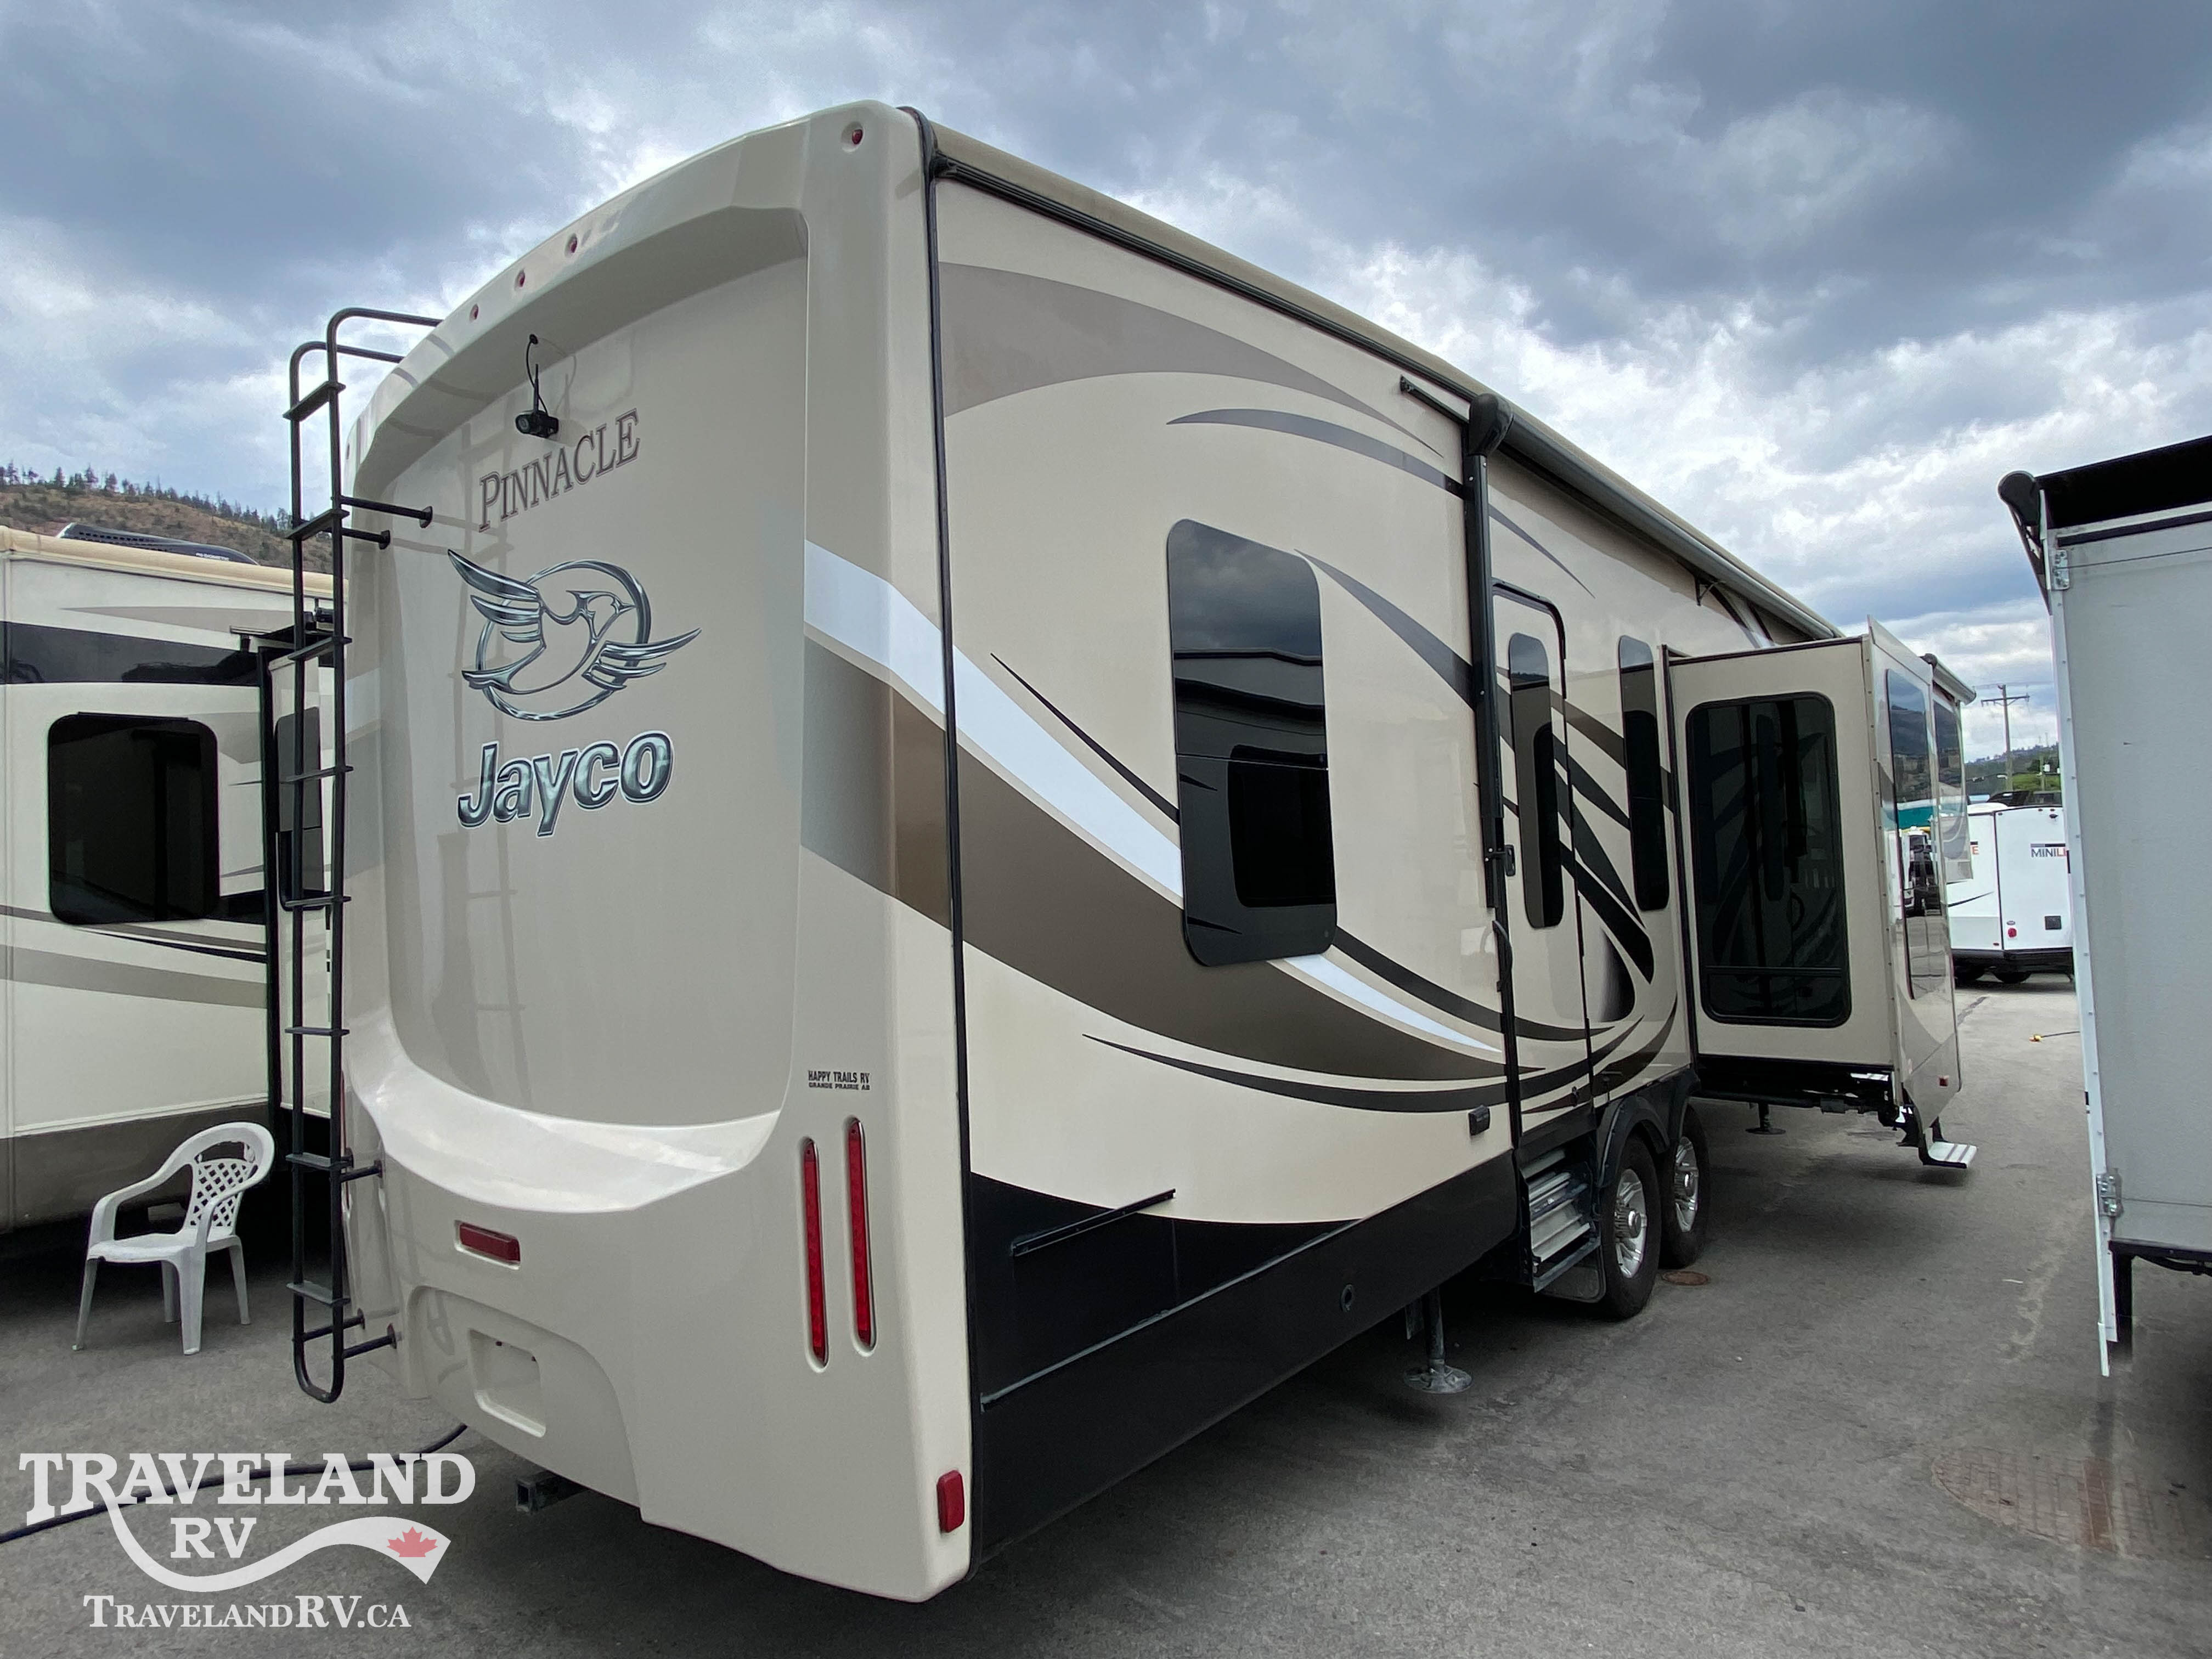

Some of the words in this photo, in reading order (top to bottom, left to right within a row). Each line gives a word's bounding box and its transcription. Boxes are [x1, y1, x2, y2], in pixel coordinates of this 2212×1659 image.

[479, 408, 640, 533] PINNACLE
[458, 730, 674, 838] Jayco
[808, 1070, 831, 1081] HAPPY
[833, 1071, 857, 1083] TRAILS
[860, 1073, 870, 1084] RV
